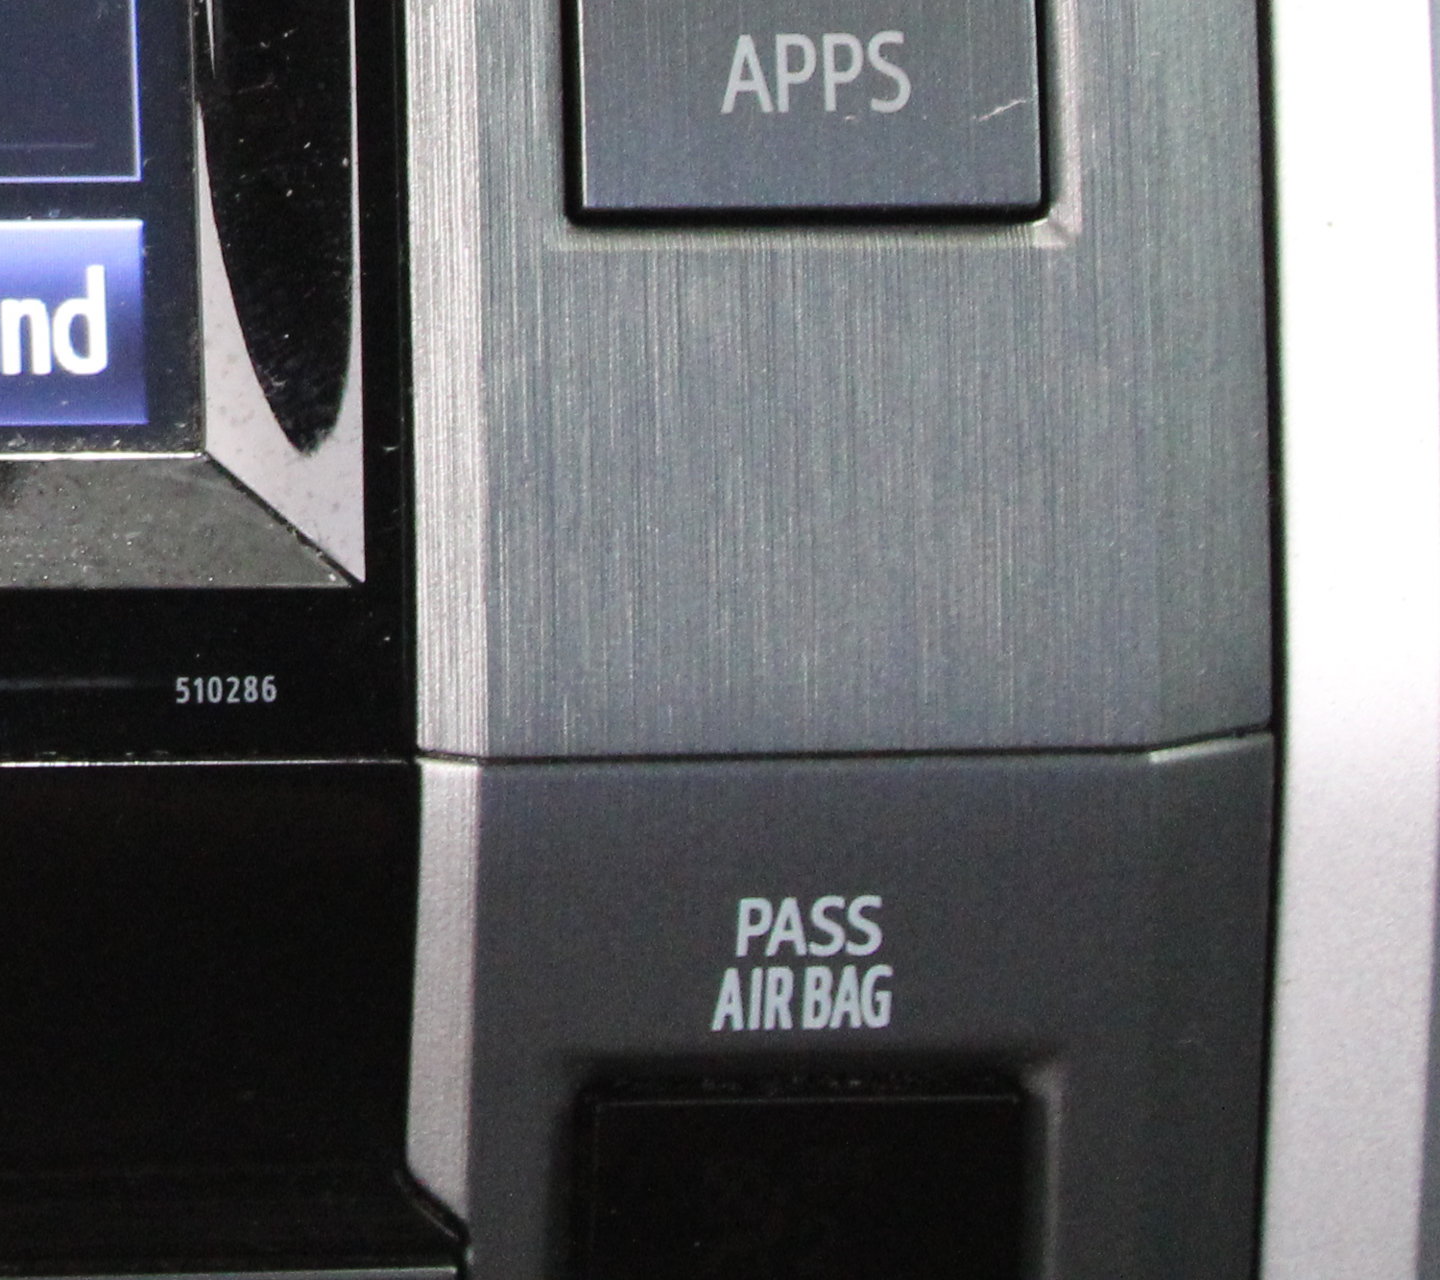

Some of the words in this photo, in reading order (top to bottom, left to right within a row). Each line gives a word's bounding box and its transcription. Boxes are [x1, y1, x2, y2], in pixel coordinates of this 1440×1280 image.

[720, 29, 912, 114] APPS
[175, 674, 279, 705] 510286
[734, 893, 884, 958] PASS
